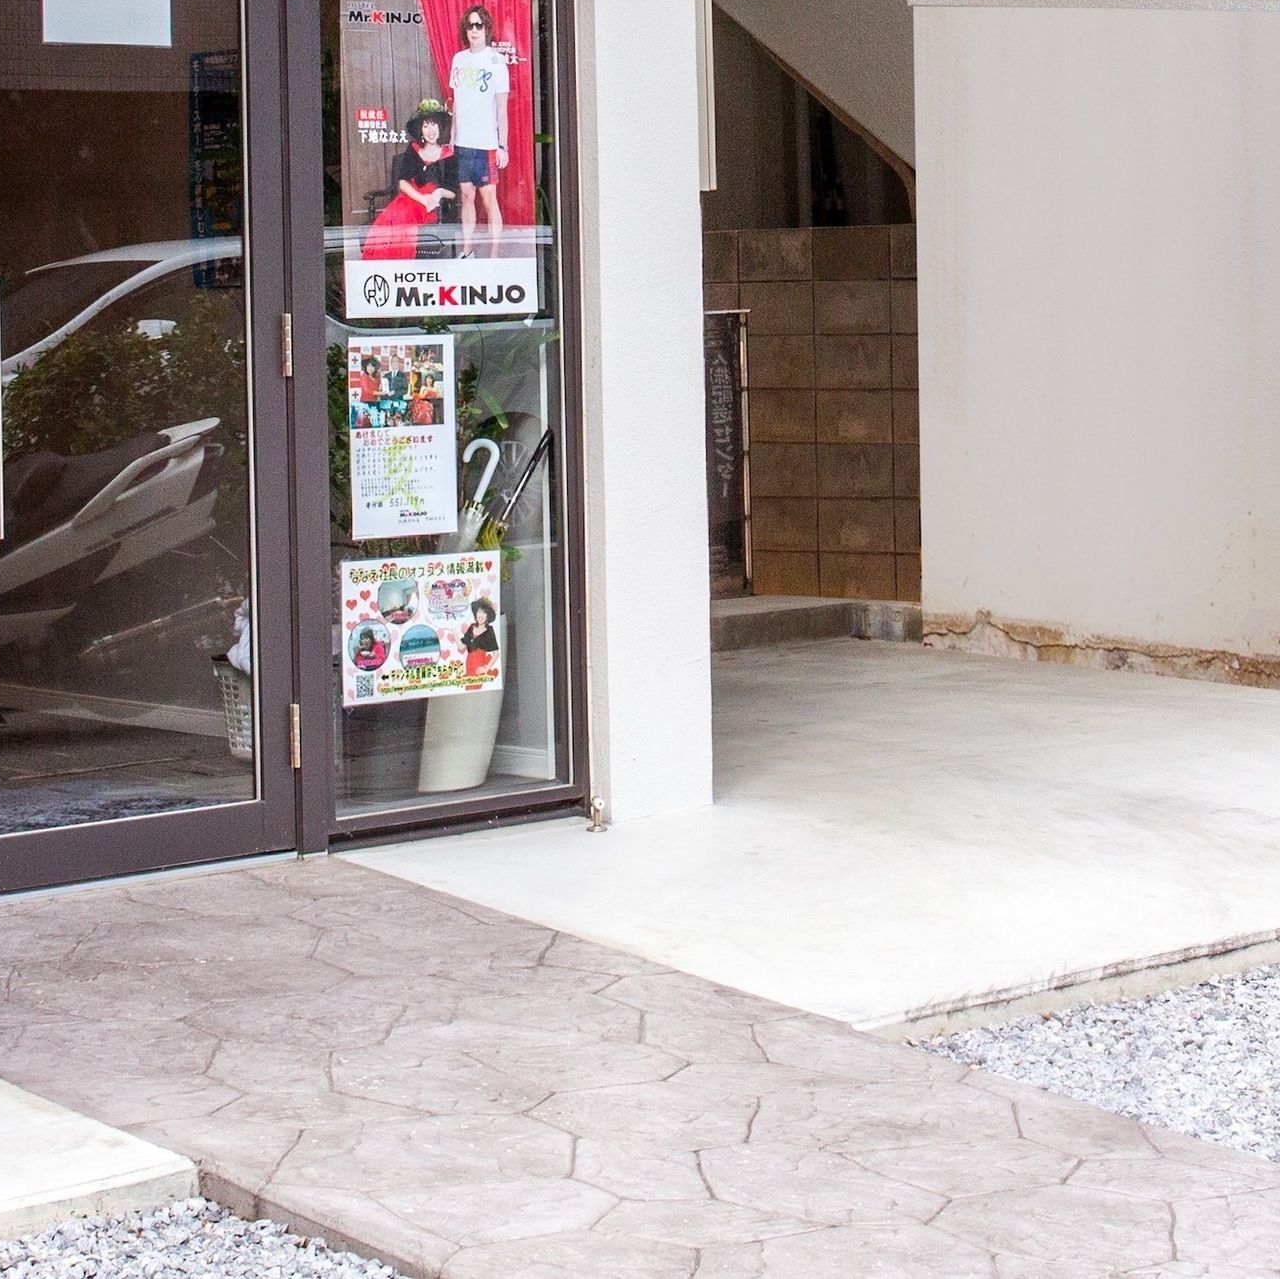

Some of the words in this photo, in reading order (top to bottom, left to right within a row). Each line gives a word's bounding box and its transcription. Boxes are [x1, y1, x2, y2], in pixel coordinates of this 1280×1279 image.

[349, 10, 423, 24] Mr.KINJO
[394, 272, 442, 283] HOTEL
[395, 284, 526, 308] Mr.KINJO
[355, 429, 391, 439] あけまして
[363, 435, 434, 447] おめでとうございます
